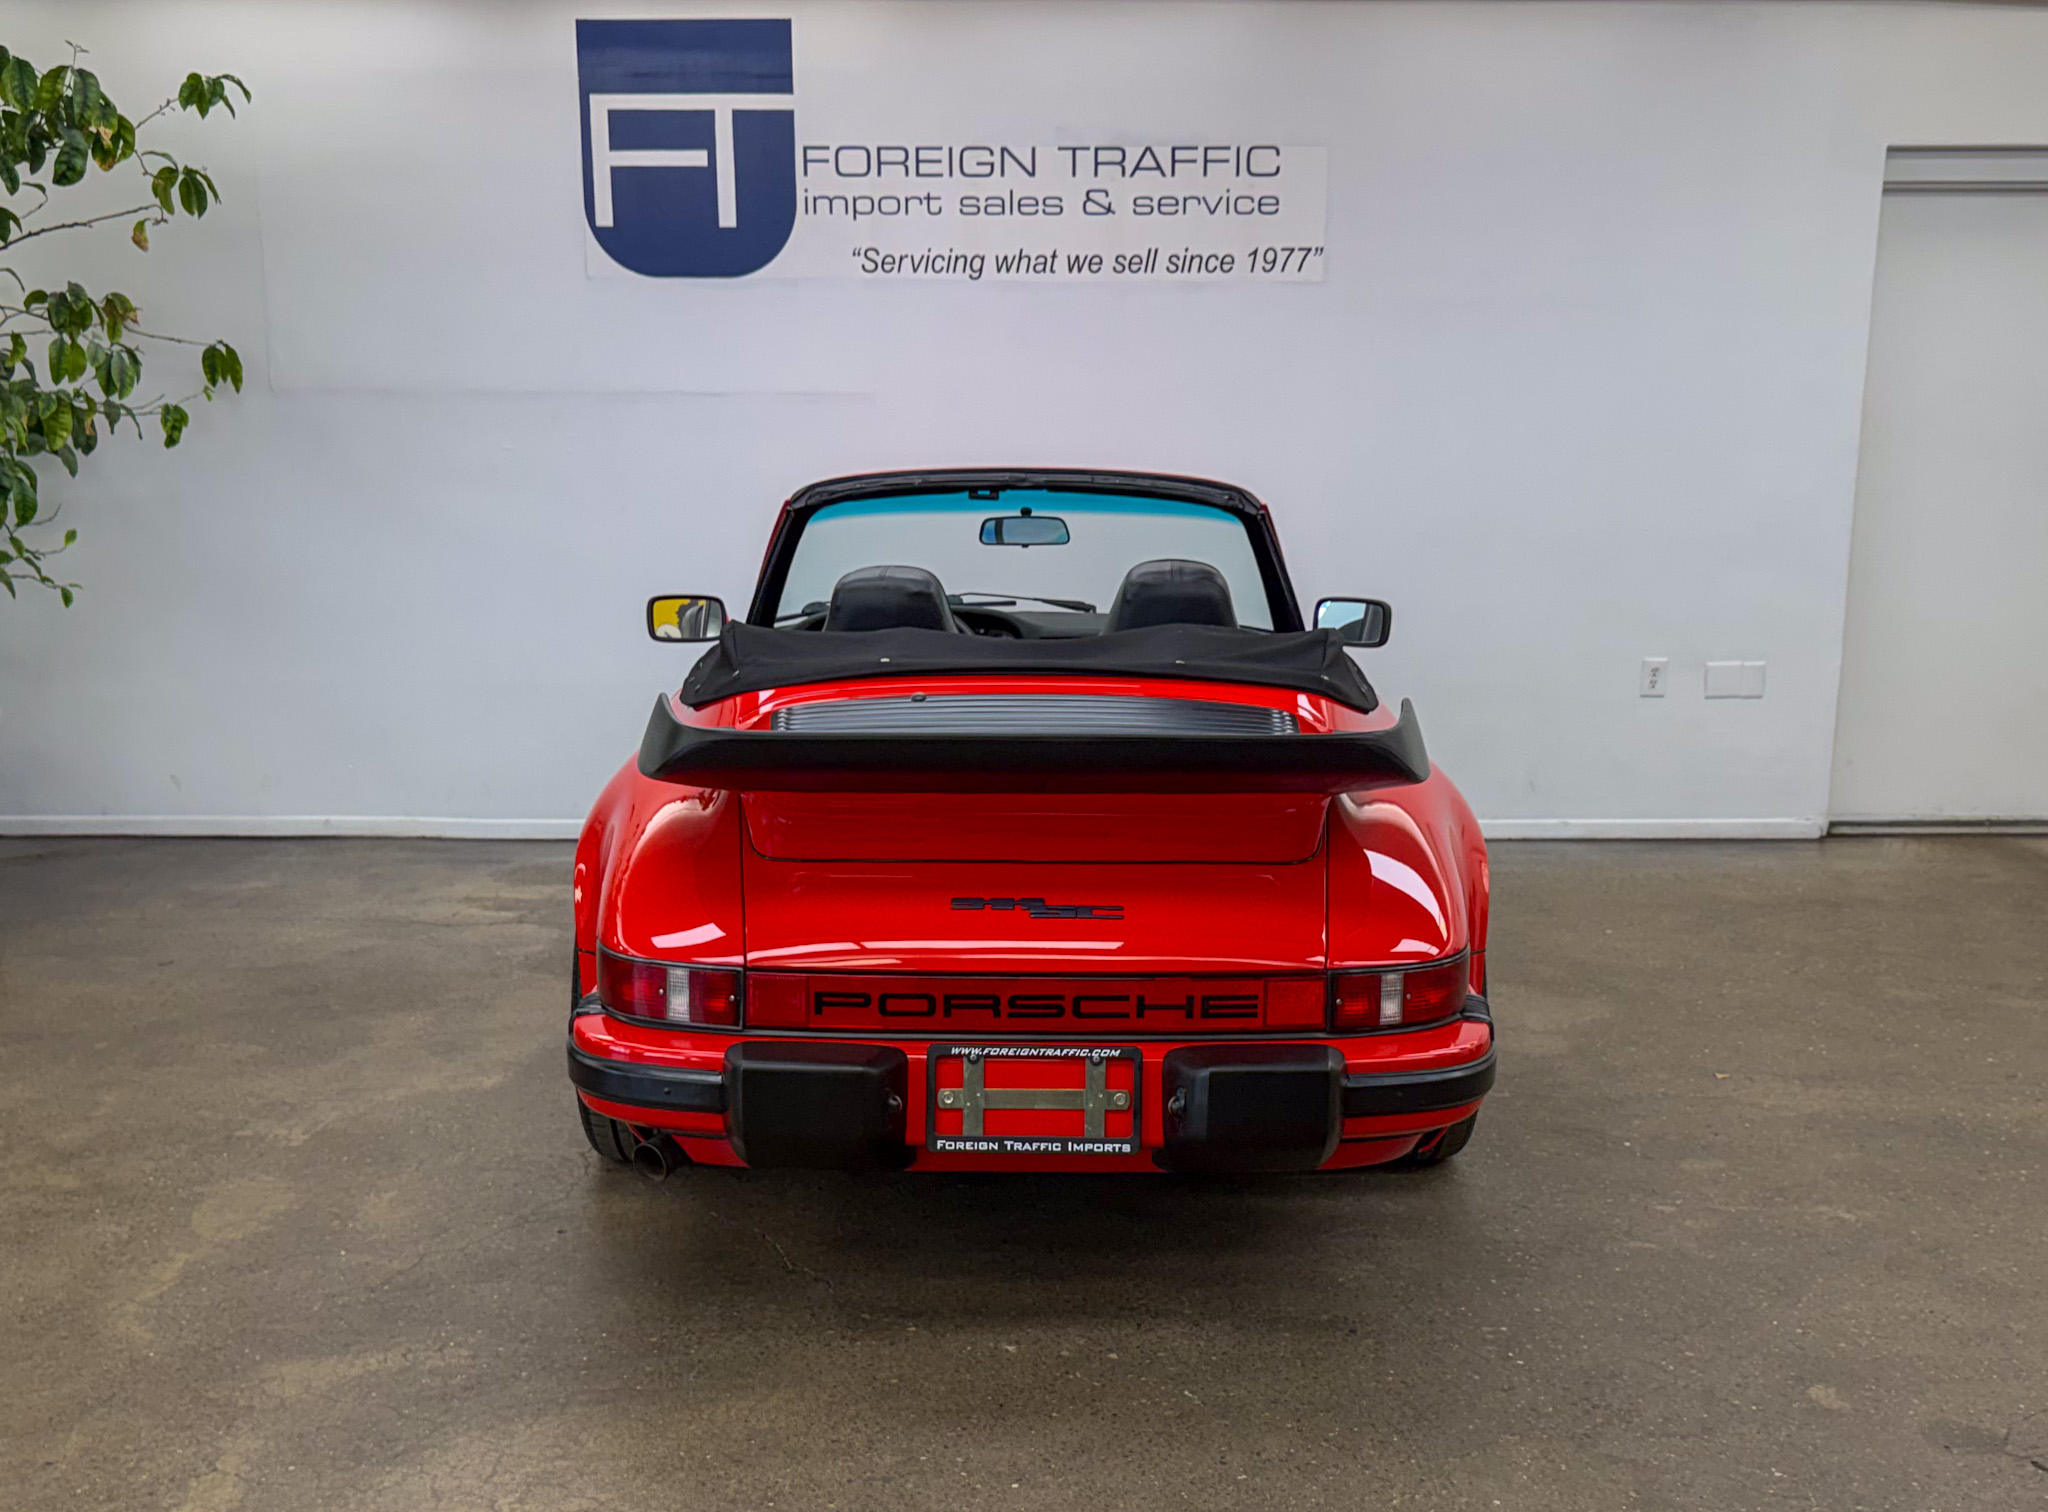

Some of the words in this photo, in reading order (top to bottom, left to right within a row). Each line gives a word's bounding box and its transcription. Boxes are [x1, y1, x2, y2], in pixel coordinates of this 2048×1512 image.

[589, 93, 795, 229] FT
[802, 145, 1037, 178] FOREIGN
[1057, 145, 1281, 178] TRAFFIC
[804, 188, 943, 221] import
[959, 189, 1064, 216] sales
[1082, 188, 1116, 216] &
[1132, 188, 1281, 216] service
[852, 247, 986, 281] “Servicing
[995, 248, 1058, 274] what
[1067, 253, 1104, 274] we
[1112, 248, 1159, 274] sell
[1166, 247, 1236, 274] since
[1247, 247, 1324, 274] 1977”
[813, 991, 1260, 1019] PORSCHE
[951, 1046, 1121, 1058] WWW.FOREIGNTRAFFIC.COM
[936, 1139, 999, 1151] FOREIGN
[1004, 1140, 1062, 1152] TRAFFIC
[1068, 1141, 1131, 1153] IMPORTS
